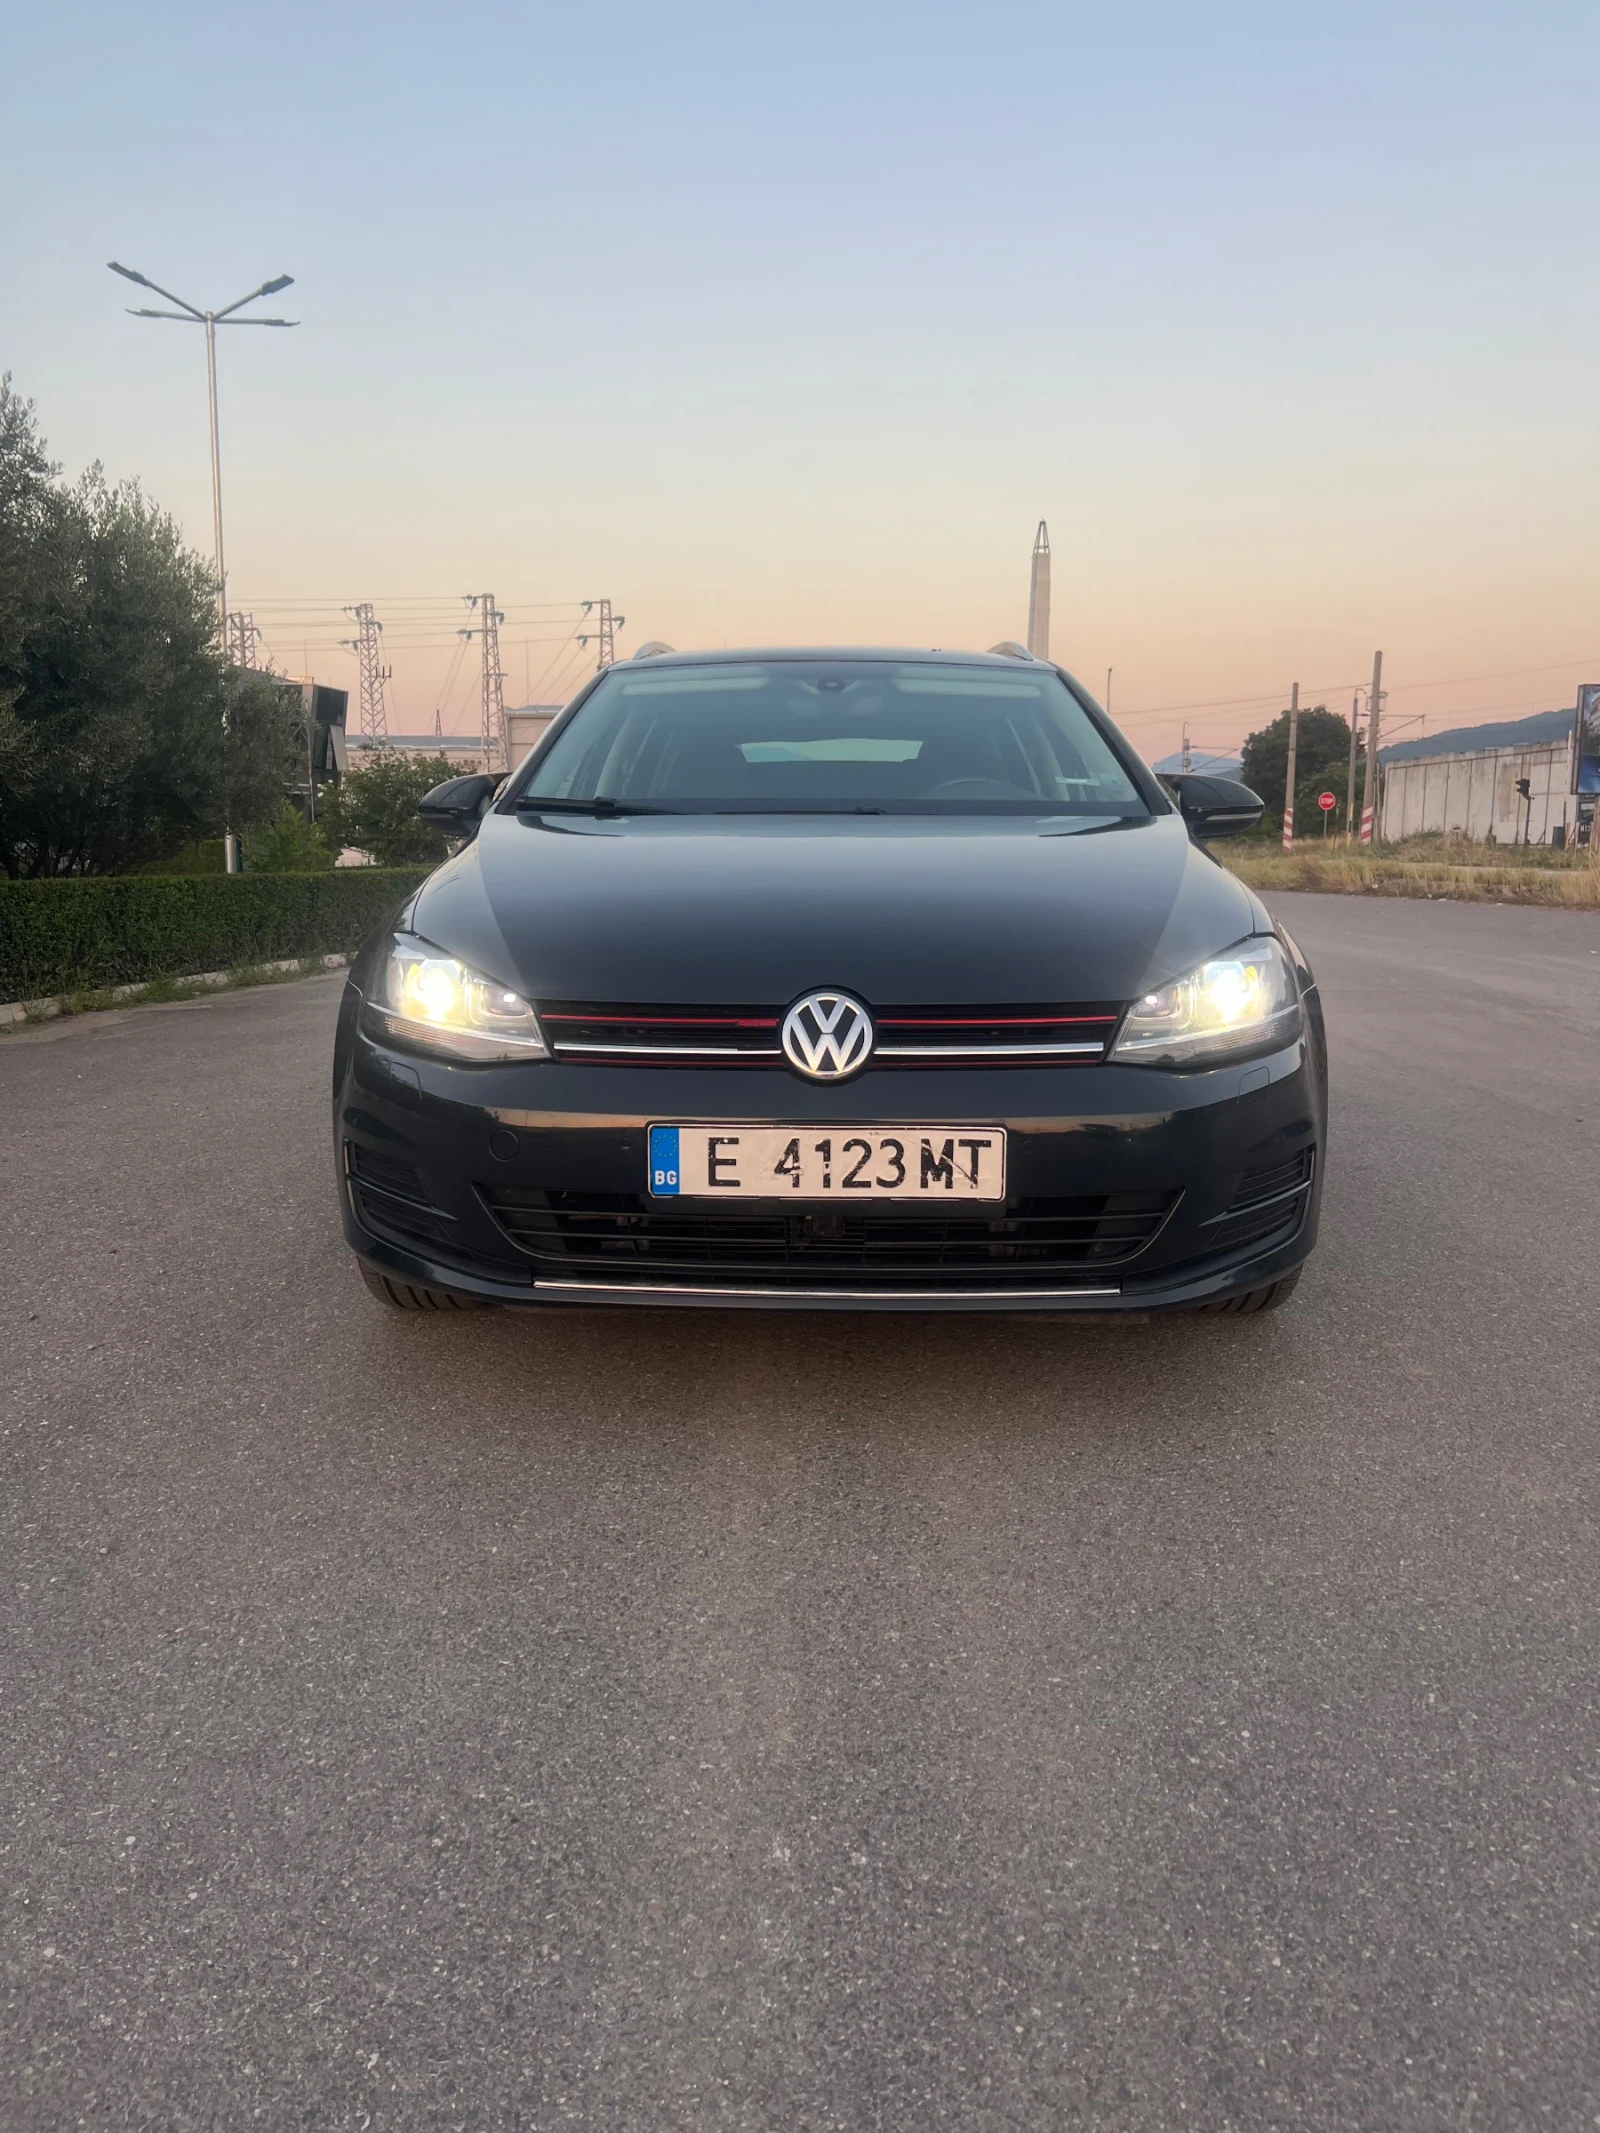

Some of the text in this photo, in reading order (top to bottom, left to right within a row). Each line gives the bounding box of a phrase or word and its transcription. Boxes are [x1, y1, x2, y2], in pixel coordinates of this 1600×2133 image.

[1320, 797, 1334, 805] STOP
[785, 994, 870, 1078] VW
[654, 1170, 677, 1186] BG
[708, 1137, 992, 1190] E 4123 MT
